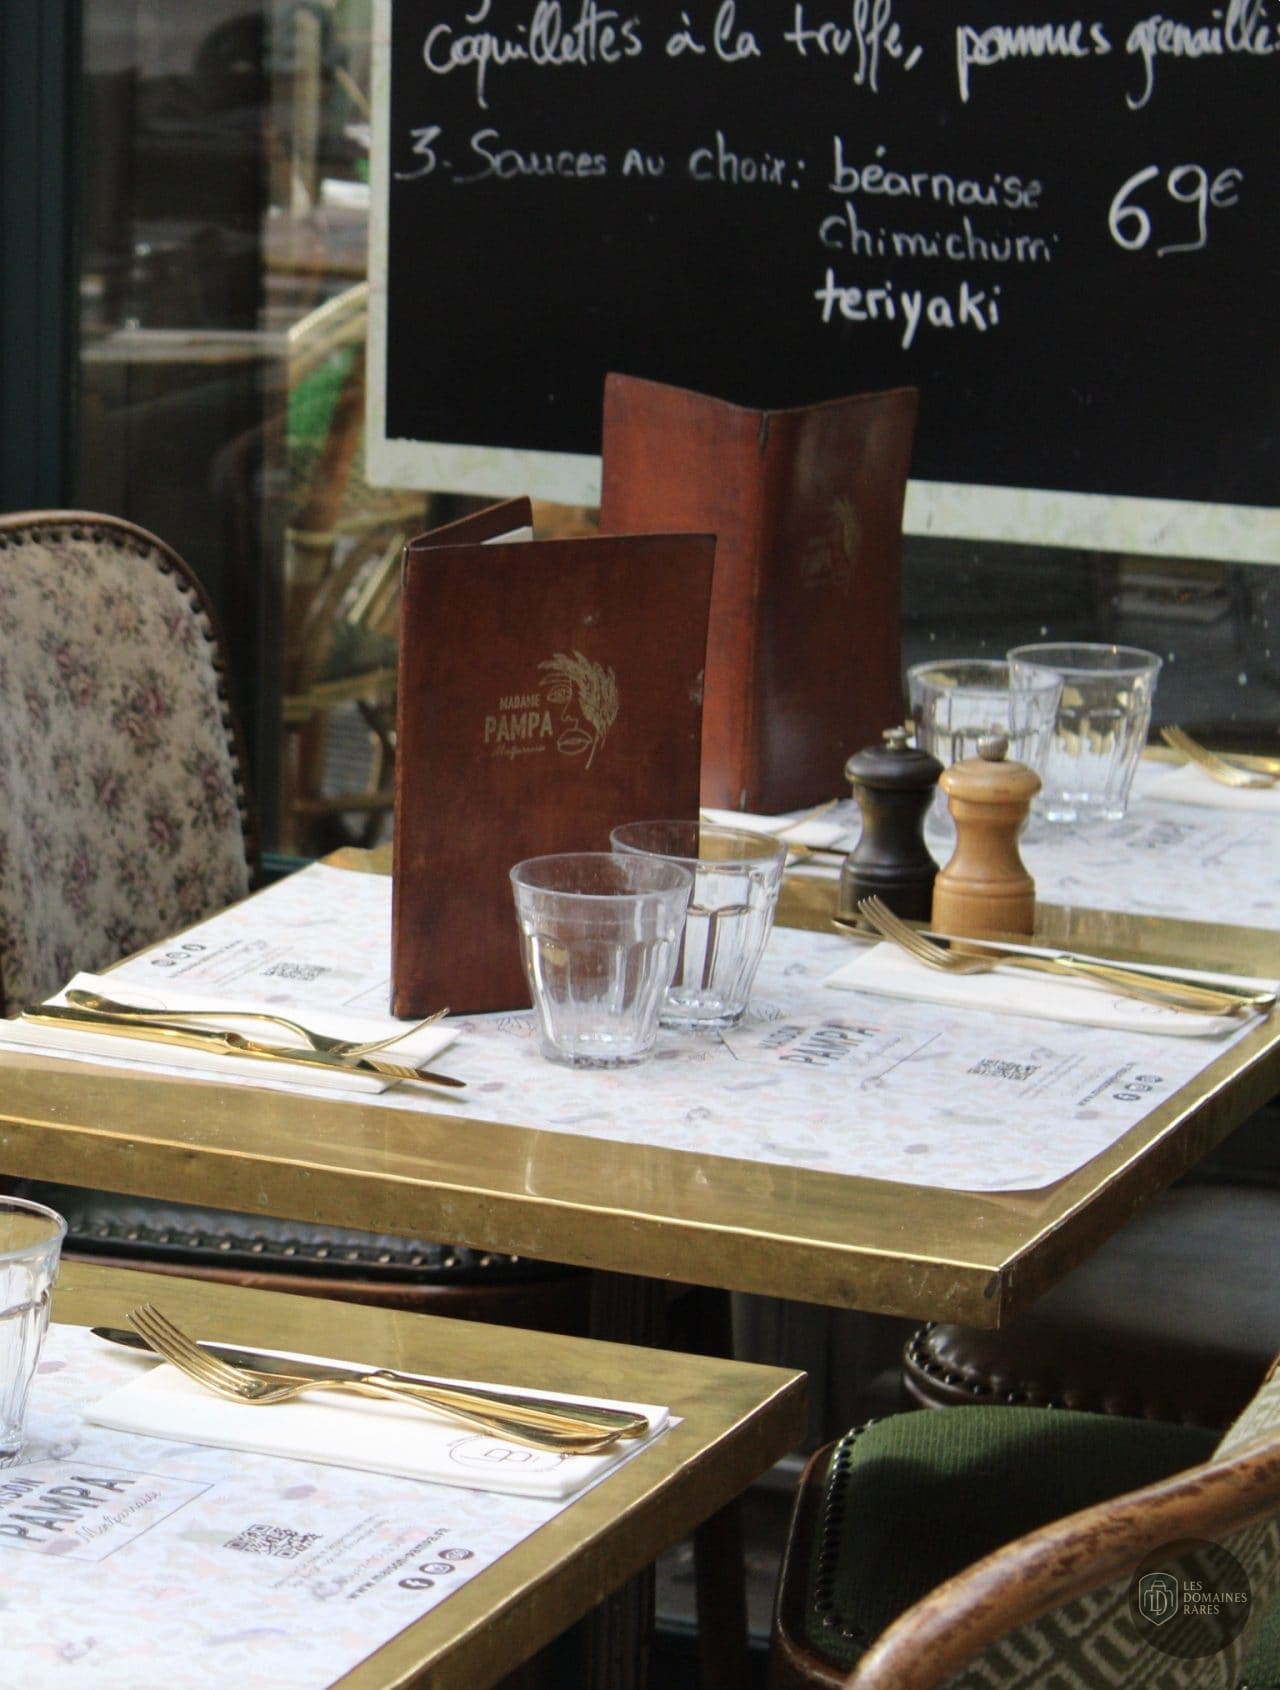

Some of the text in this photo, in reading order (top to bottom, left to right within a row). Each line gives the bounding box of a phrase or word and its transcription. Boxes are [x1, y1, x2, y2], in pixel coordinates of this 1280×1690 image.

[423, 0, 641, 109] coquillettes
[955, 20, 1112, 103] pommes
[452, 128, 608, 184] Sauces
[829, 134, 1042, 209] béarnaise
[814, 268, 1001, 350] teriyaki
[485, 710, 553, 743] PAMPA
